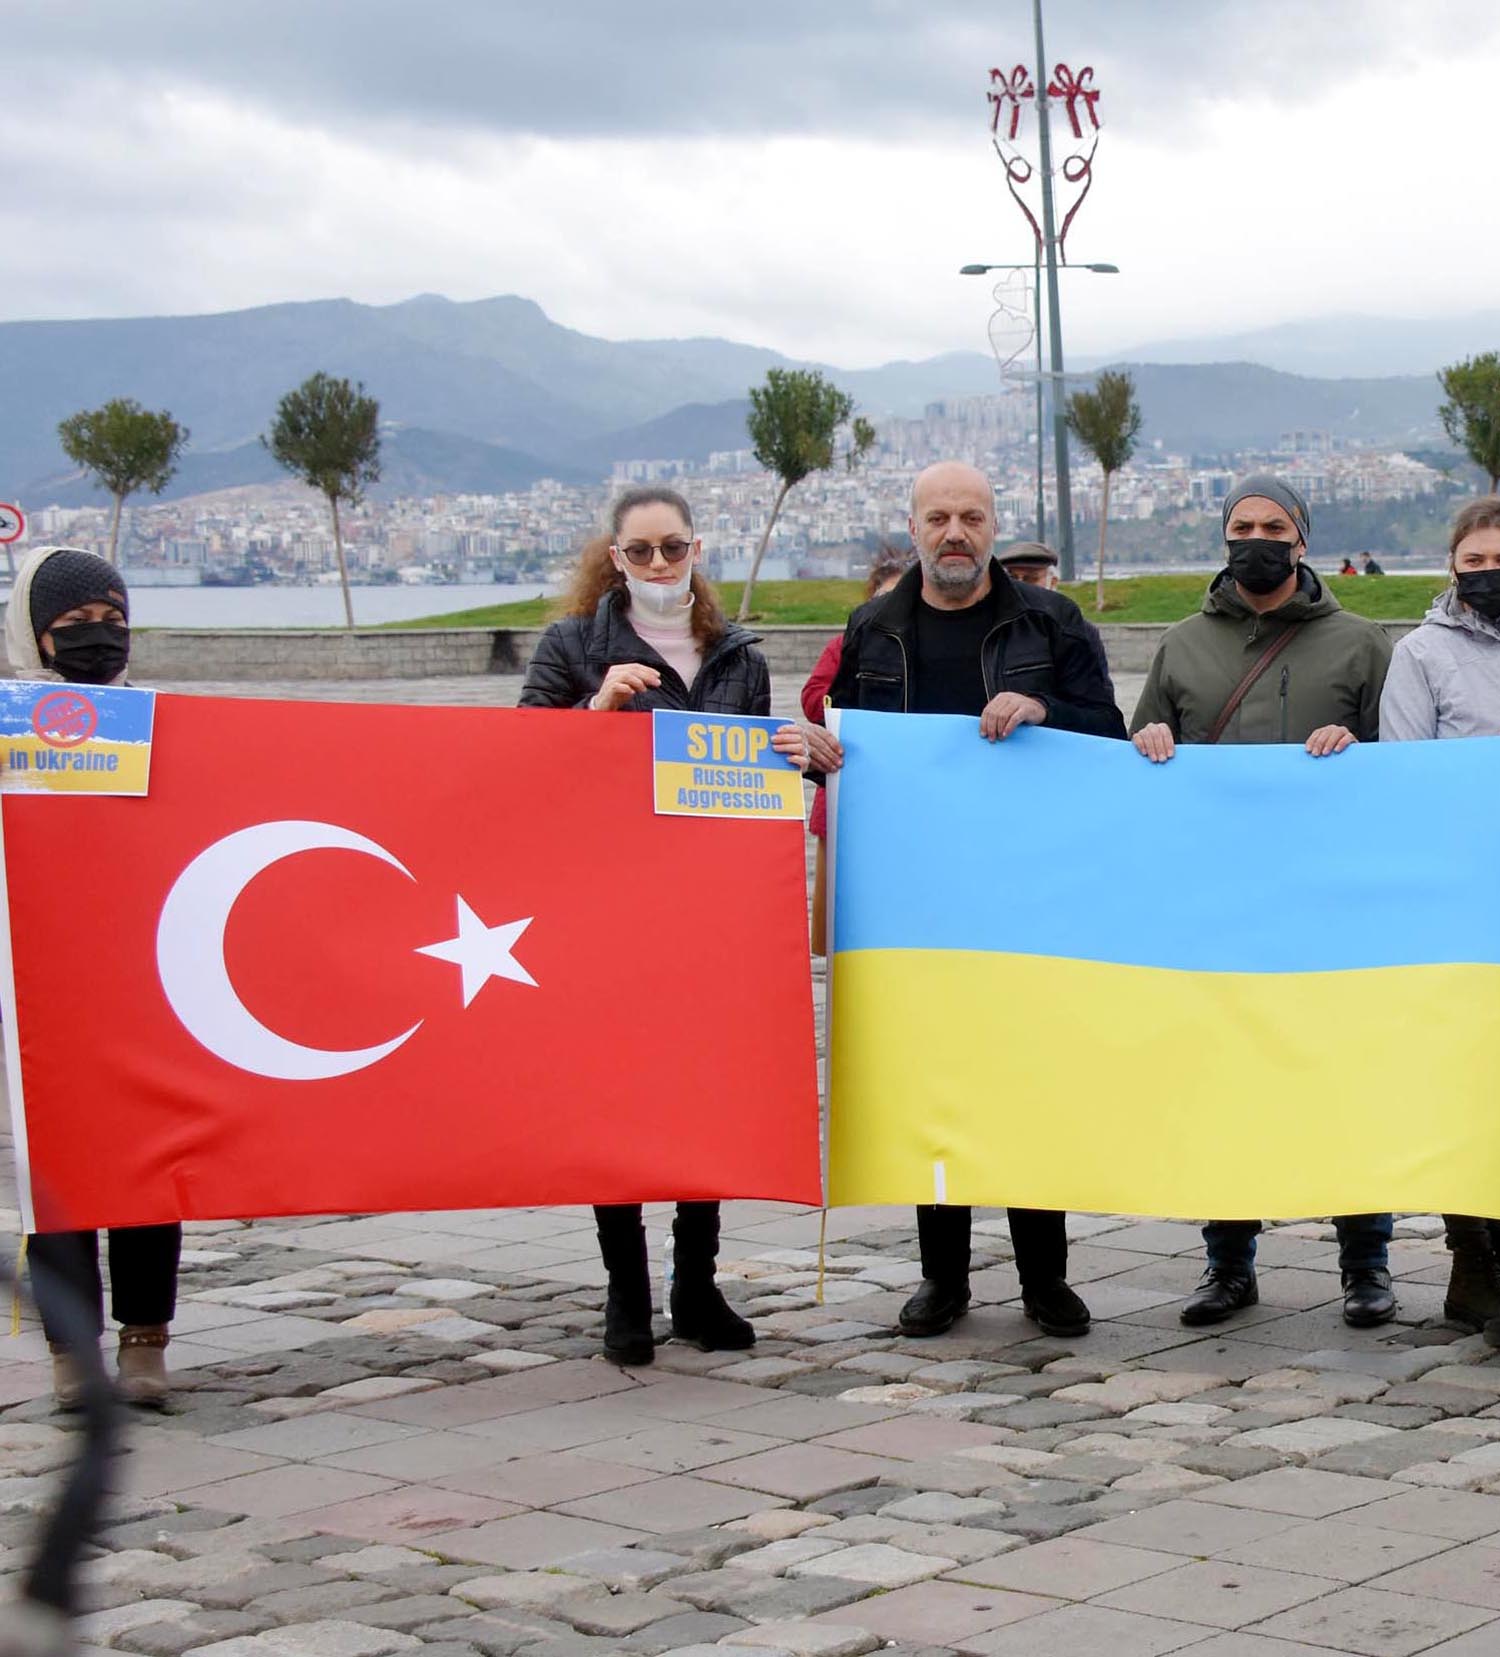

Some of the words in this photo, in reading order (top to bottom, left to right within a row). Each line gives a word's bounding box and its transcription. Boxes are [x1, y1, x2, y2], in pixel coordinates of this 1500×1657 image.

[687, 723, 769, 763] STOP
[9, 748, 29, 770] in
[692, 767, 765, 789] Russian
[677, 787, 783, 810] Aggression
